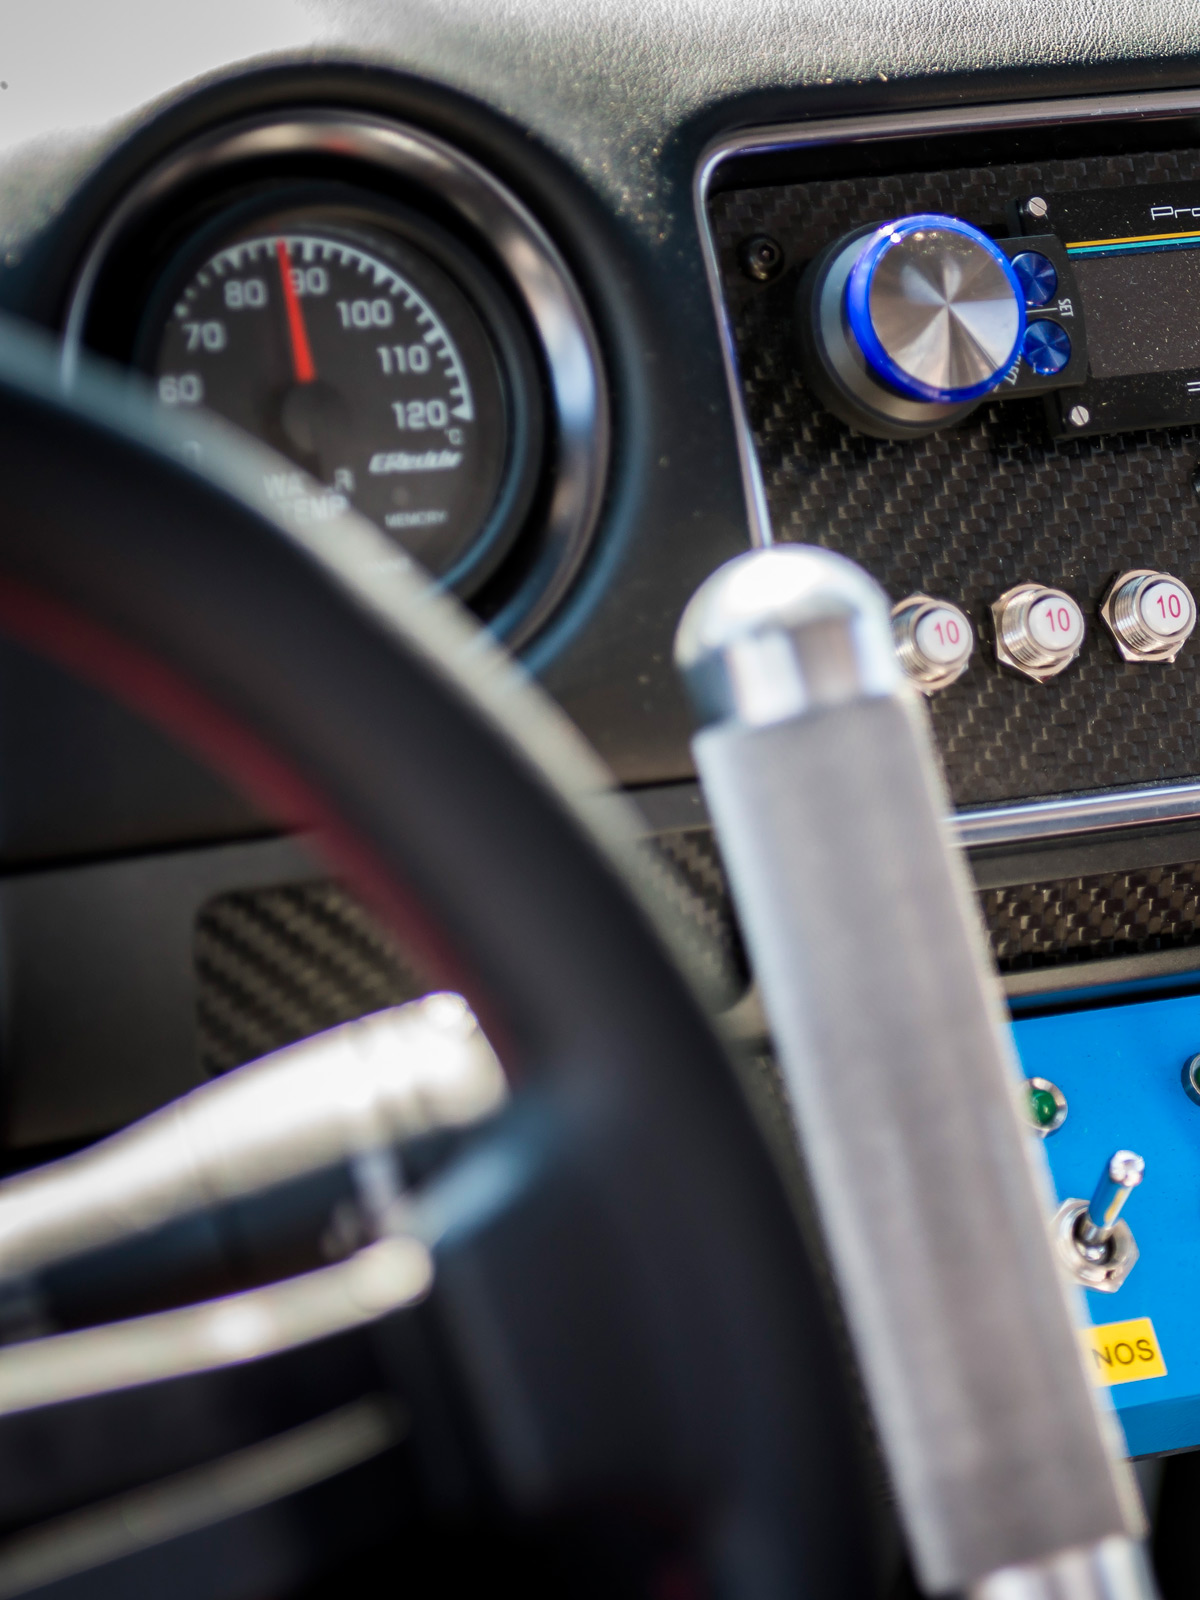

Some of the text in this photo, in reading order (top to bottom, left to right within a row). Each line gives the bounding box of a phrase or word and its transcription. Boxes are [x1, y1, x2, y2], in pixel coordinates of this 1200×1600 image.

[224, 280, 265, 308] 80
[1057, 297, 1074, 317] SET
[337, 299, 393, 327] 100
[182, 321, 225, 350] 70
[377, 345, 429, 373] 110
[158, 375, 202, 402] 60
[392, 400, 448, 429] 120
[1045, 607, 1072, 634] 10
[1156, 594, 1182, 621] 10
[933, 620, 961, 647] 10
